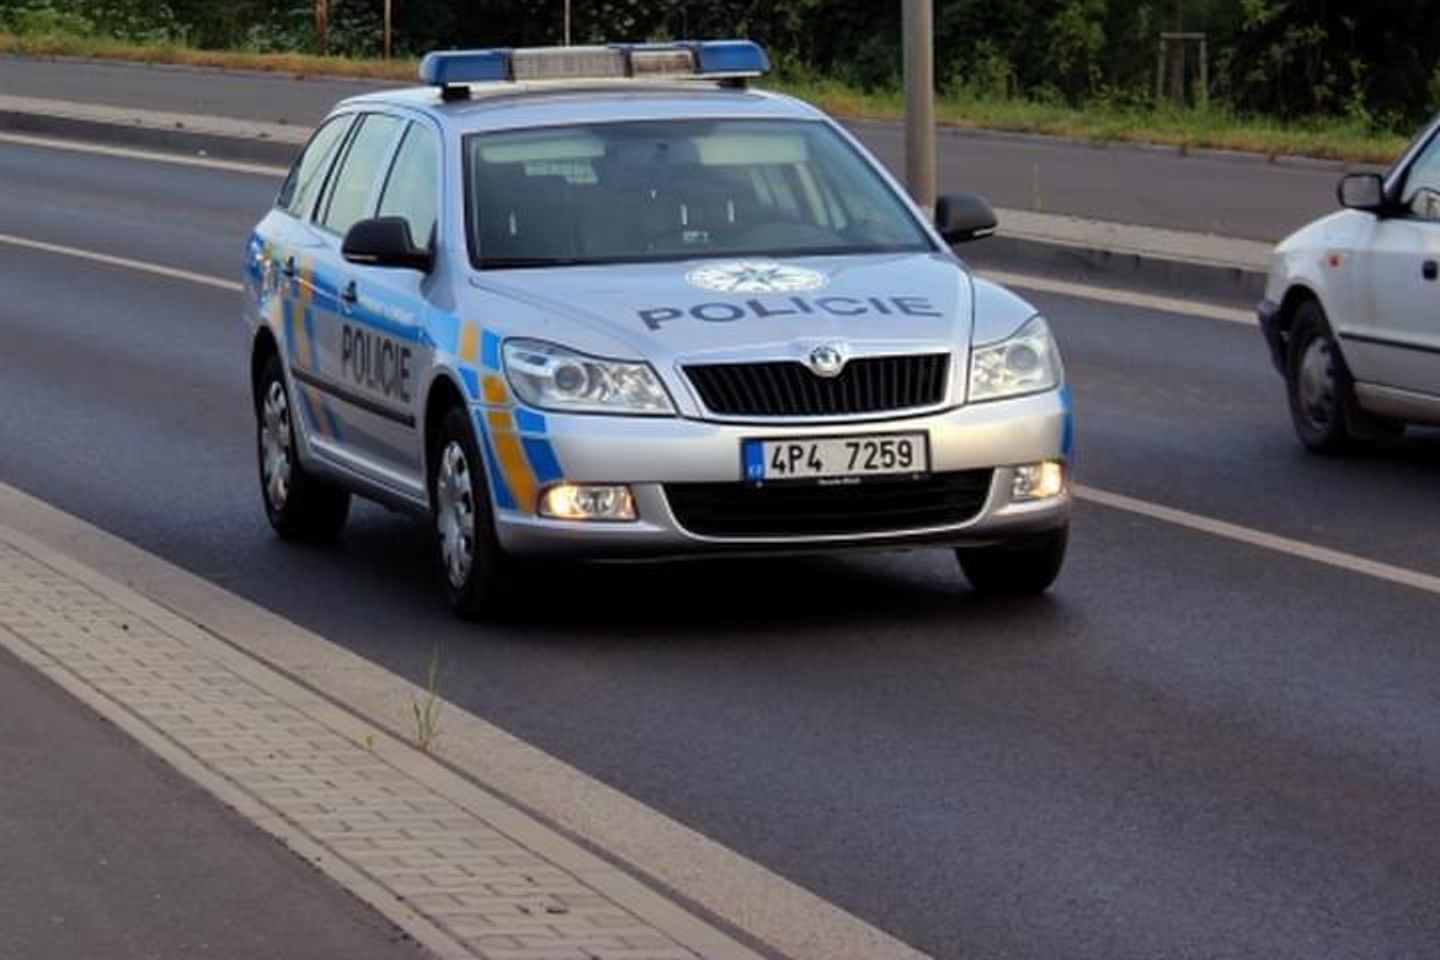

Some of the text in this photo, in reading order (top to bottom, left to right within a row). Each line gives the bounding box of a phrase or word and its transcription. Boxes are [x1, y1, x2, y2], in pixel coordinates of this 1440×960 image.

[636, 296, 944, 332] POLICIE
[341, 323, 412, 404] POLICIE
[770, 444, 823, 474] 4P4
[845, 440, 913, 471] 7259
